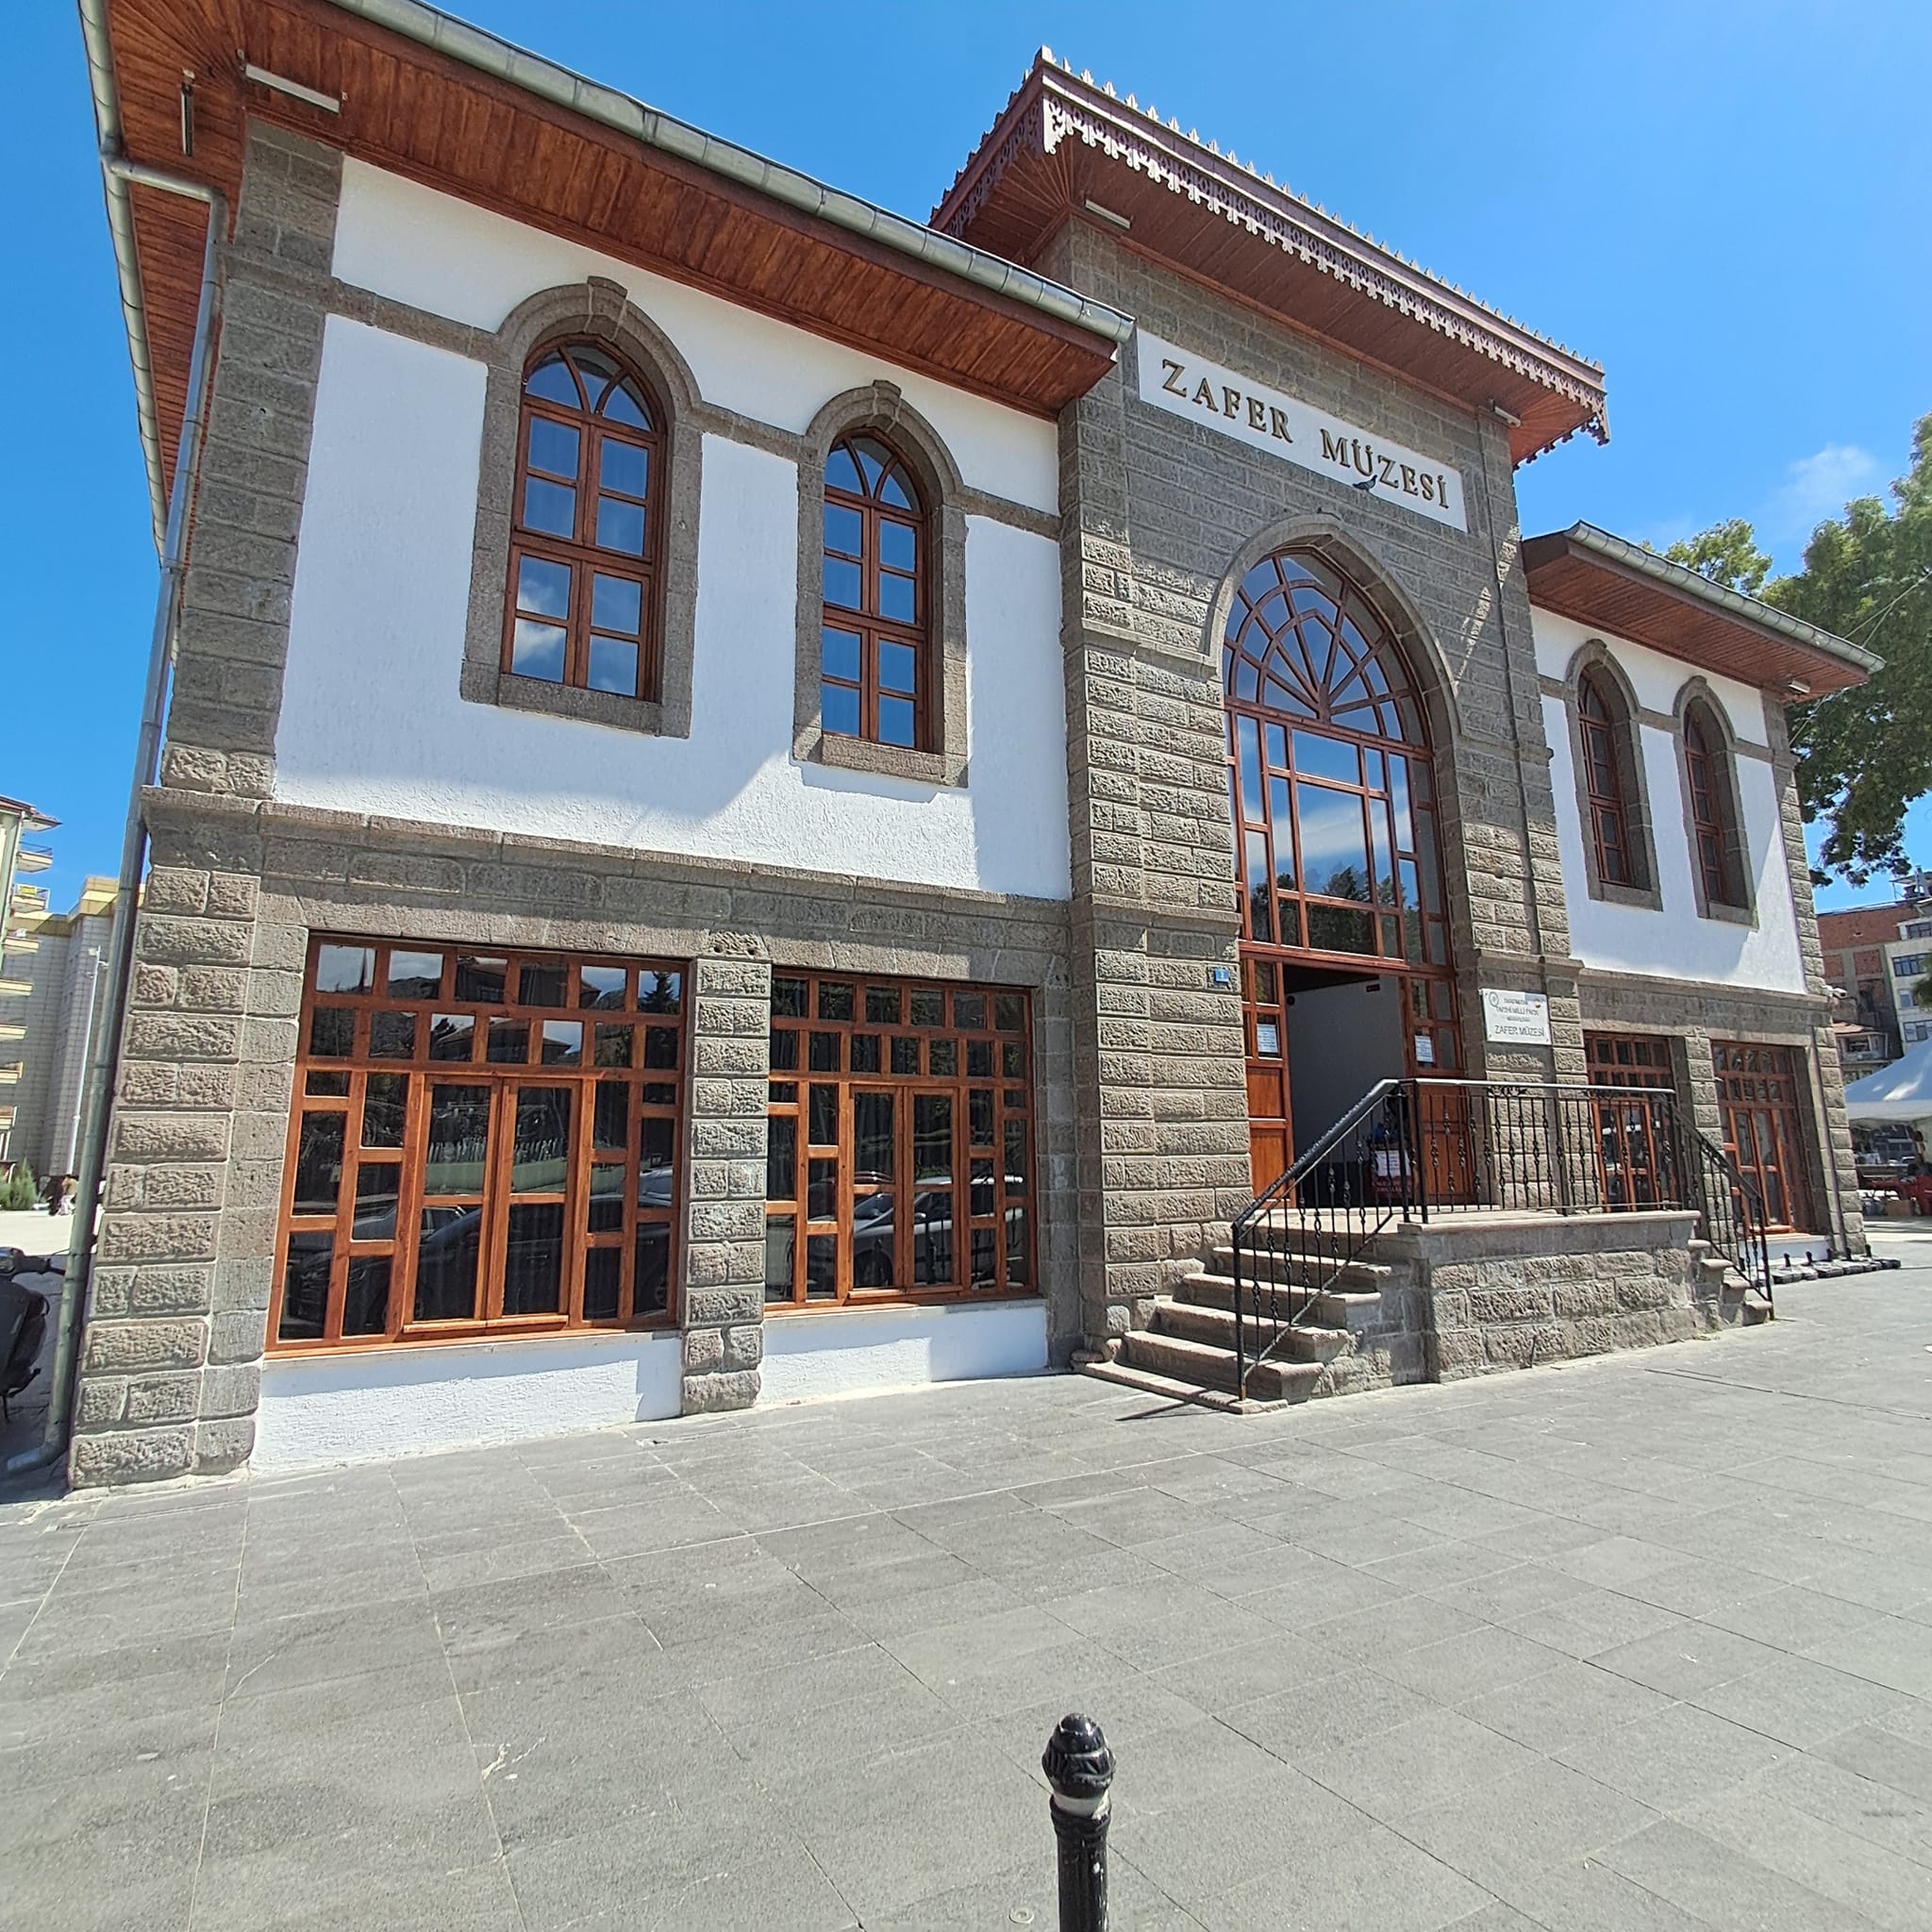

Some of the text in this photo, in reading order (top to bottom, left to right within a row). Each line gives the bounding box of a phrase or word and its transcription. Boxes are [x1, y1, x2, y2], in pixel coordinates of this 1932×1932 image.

[1162, 358, 1449, 509] ZAFER MÜZESİ
[1494, 1024, 1518, 1036] ZAFER
